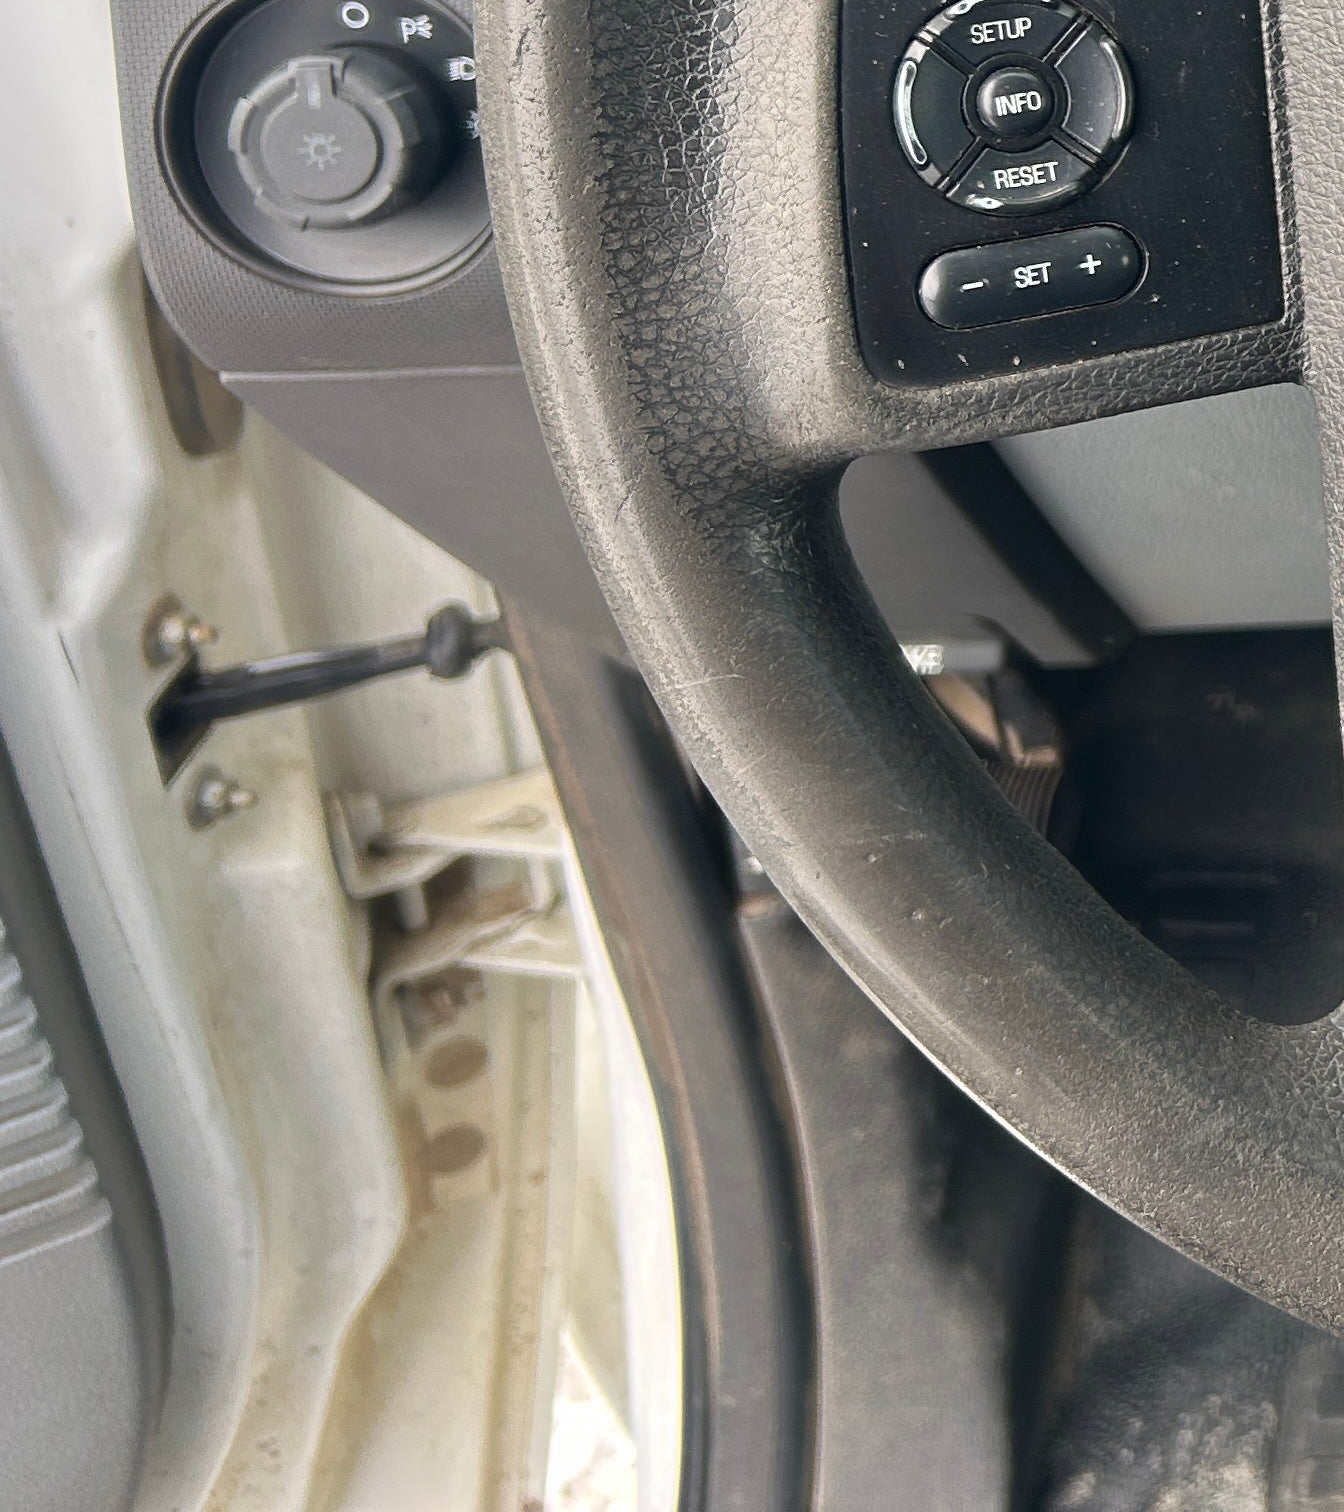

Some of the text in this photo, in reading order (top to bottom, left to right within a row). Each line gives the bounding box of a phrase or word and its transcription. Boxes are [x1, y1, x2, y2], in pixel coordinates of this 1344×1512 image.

[971, 17, 1032, 44] SETUP
[996, 90, 1042, 117] INFO
[994, 162, 1058, 189] RESET
[1014, 262, 1051, 288] SET
